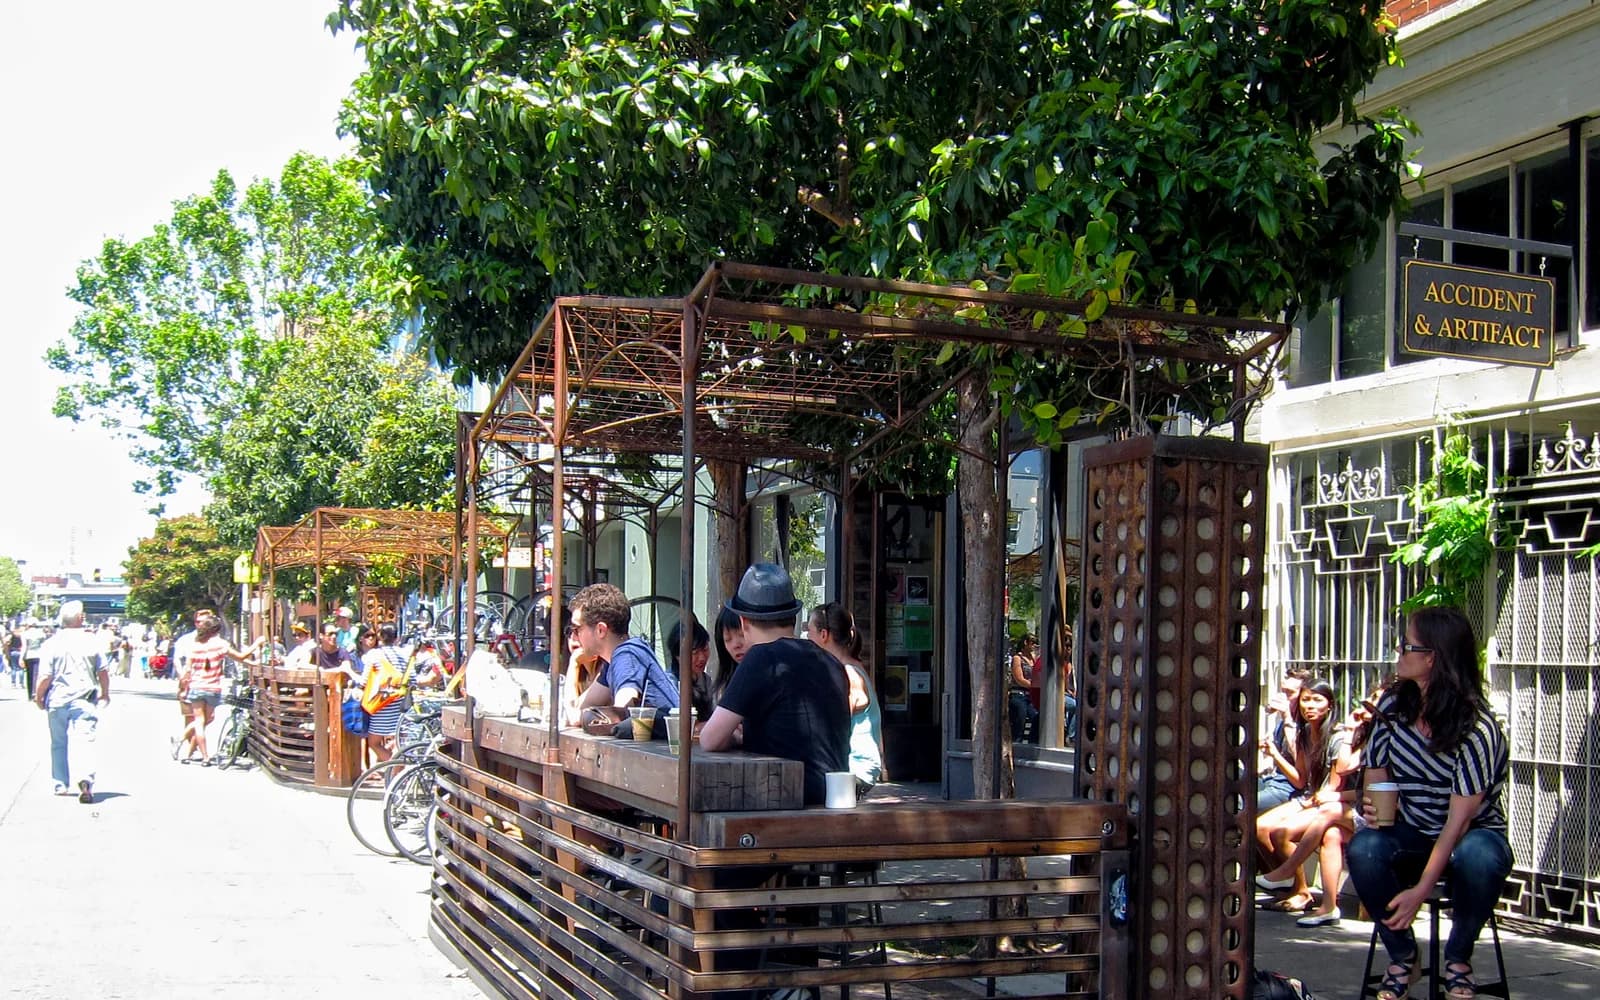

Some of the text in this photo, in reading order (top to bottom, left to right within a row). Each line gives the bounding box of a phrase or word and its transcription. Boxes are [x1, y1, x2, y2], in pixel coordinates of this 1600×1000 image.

[1424, 281, 1536, 314] ACCIDENT
[1414, 314, 1544, 349] & ARTIFACT
